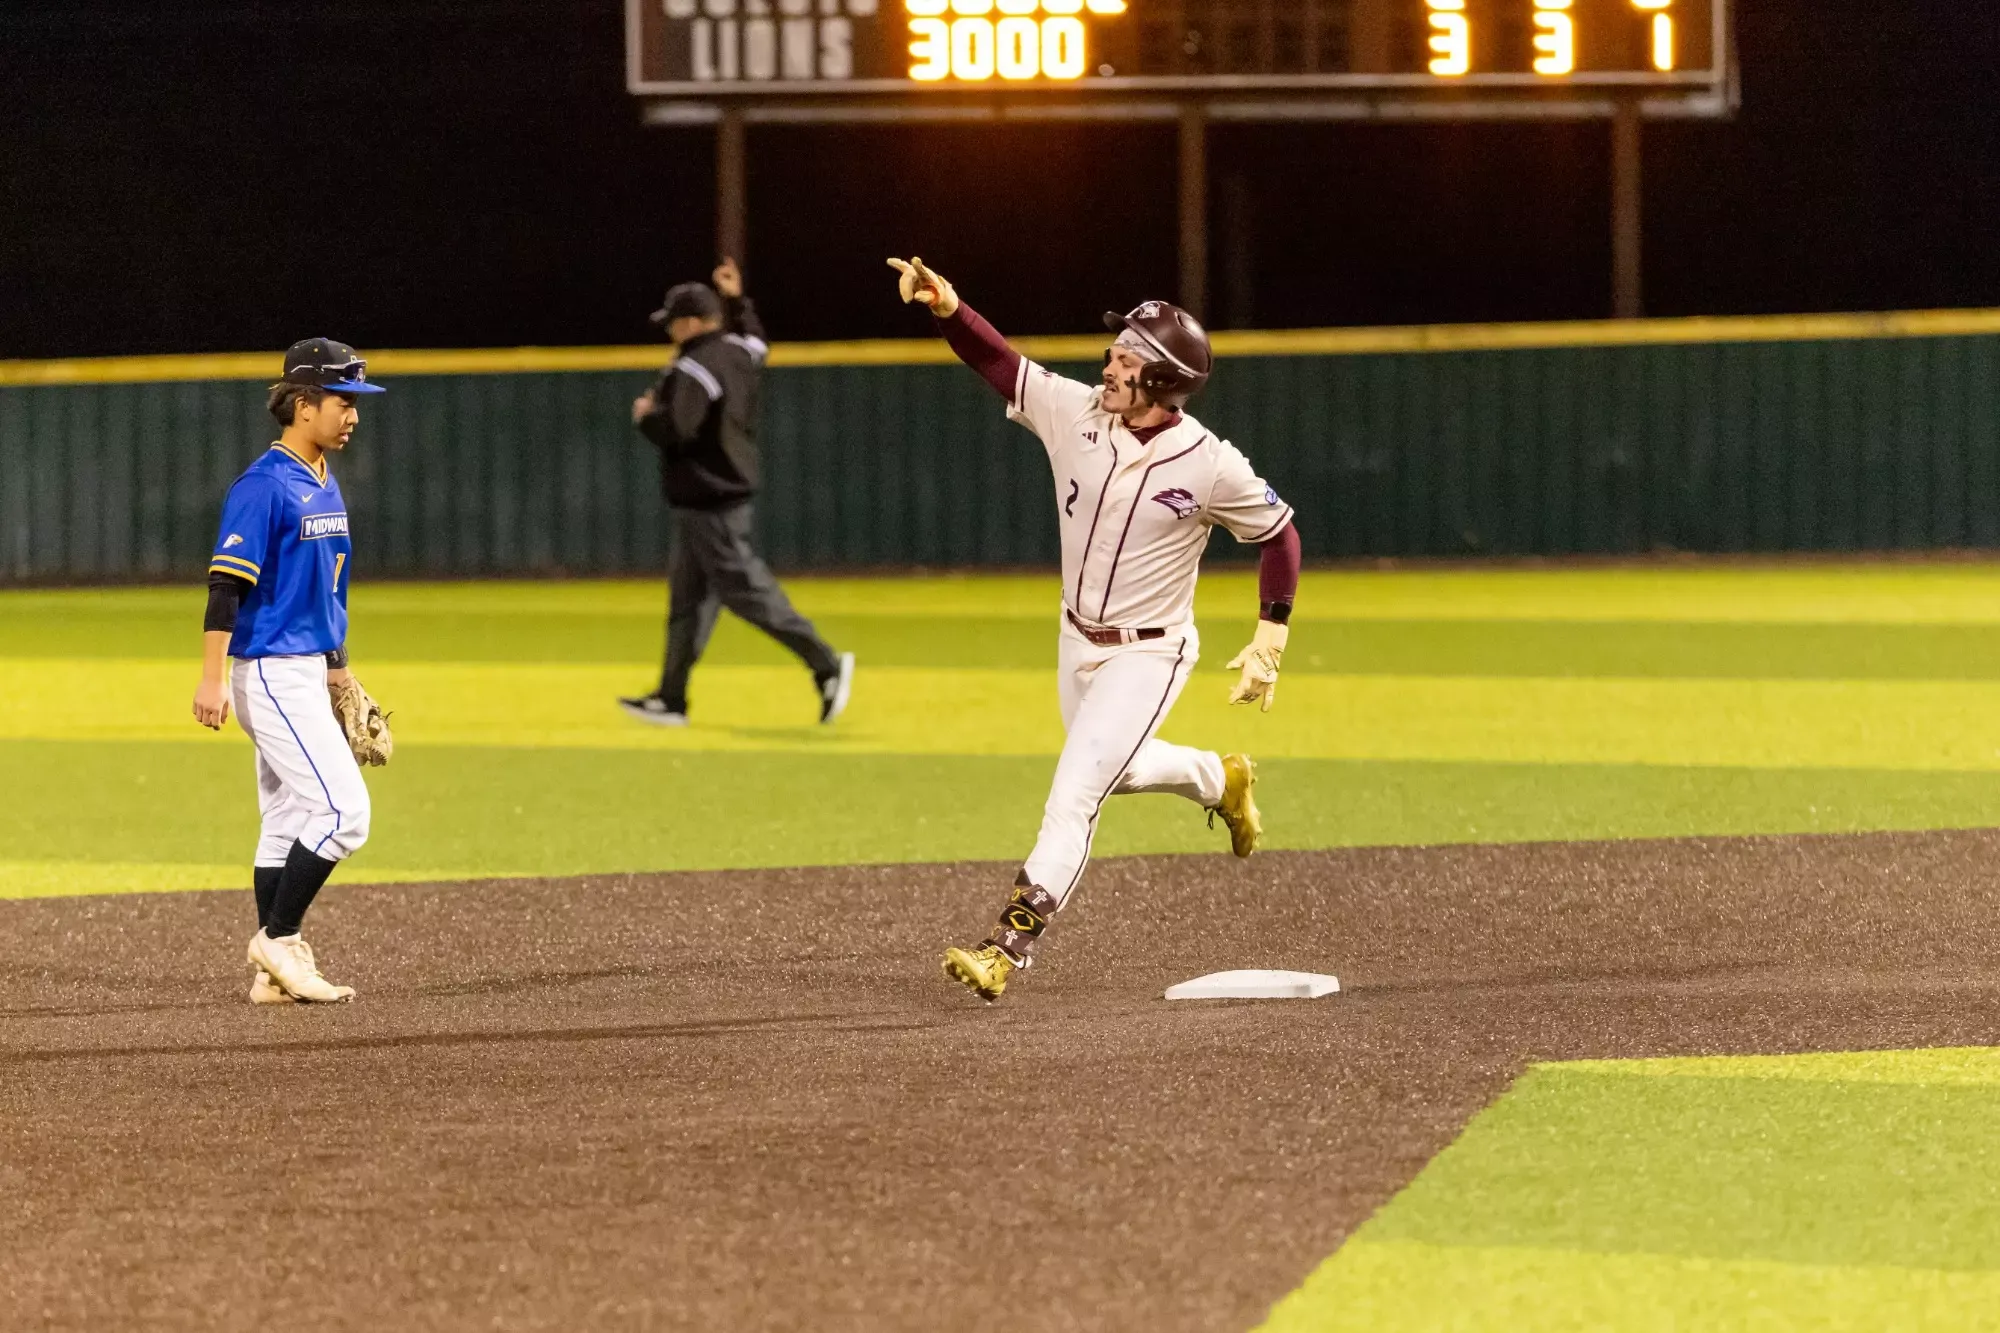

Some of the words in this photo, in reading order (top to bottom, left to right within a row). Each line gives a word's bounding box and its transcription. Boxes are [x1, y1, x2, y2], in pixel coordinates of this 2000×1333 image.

[1427, 11, 1469, 75] 3
[1532, 11, 1574, 75] 3
[1652, 12, 1672, 71] 1
[1065, 478, 1079, 518] 2
